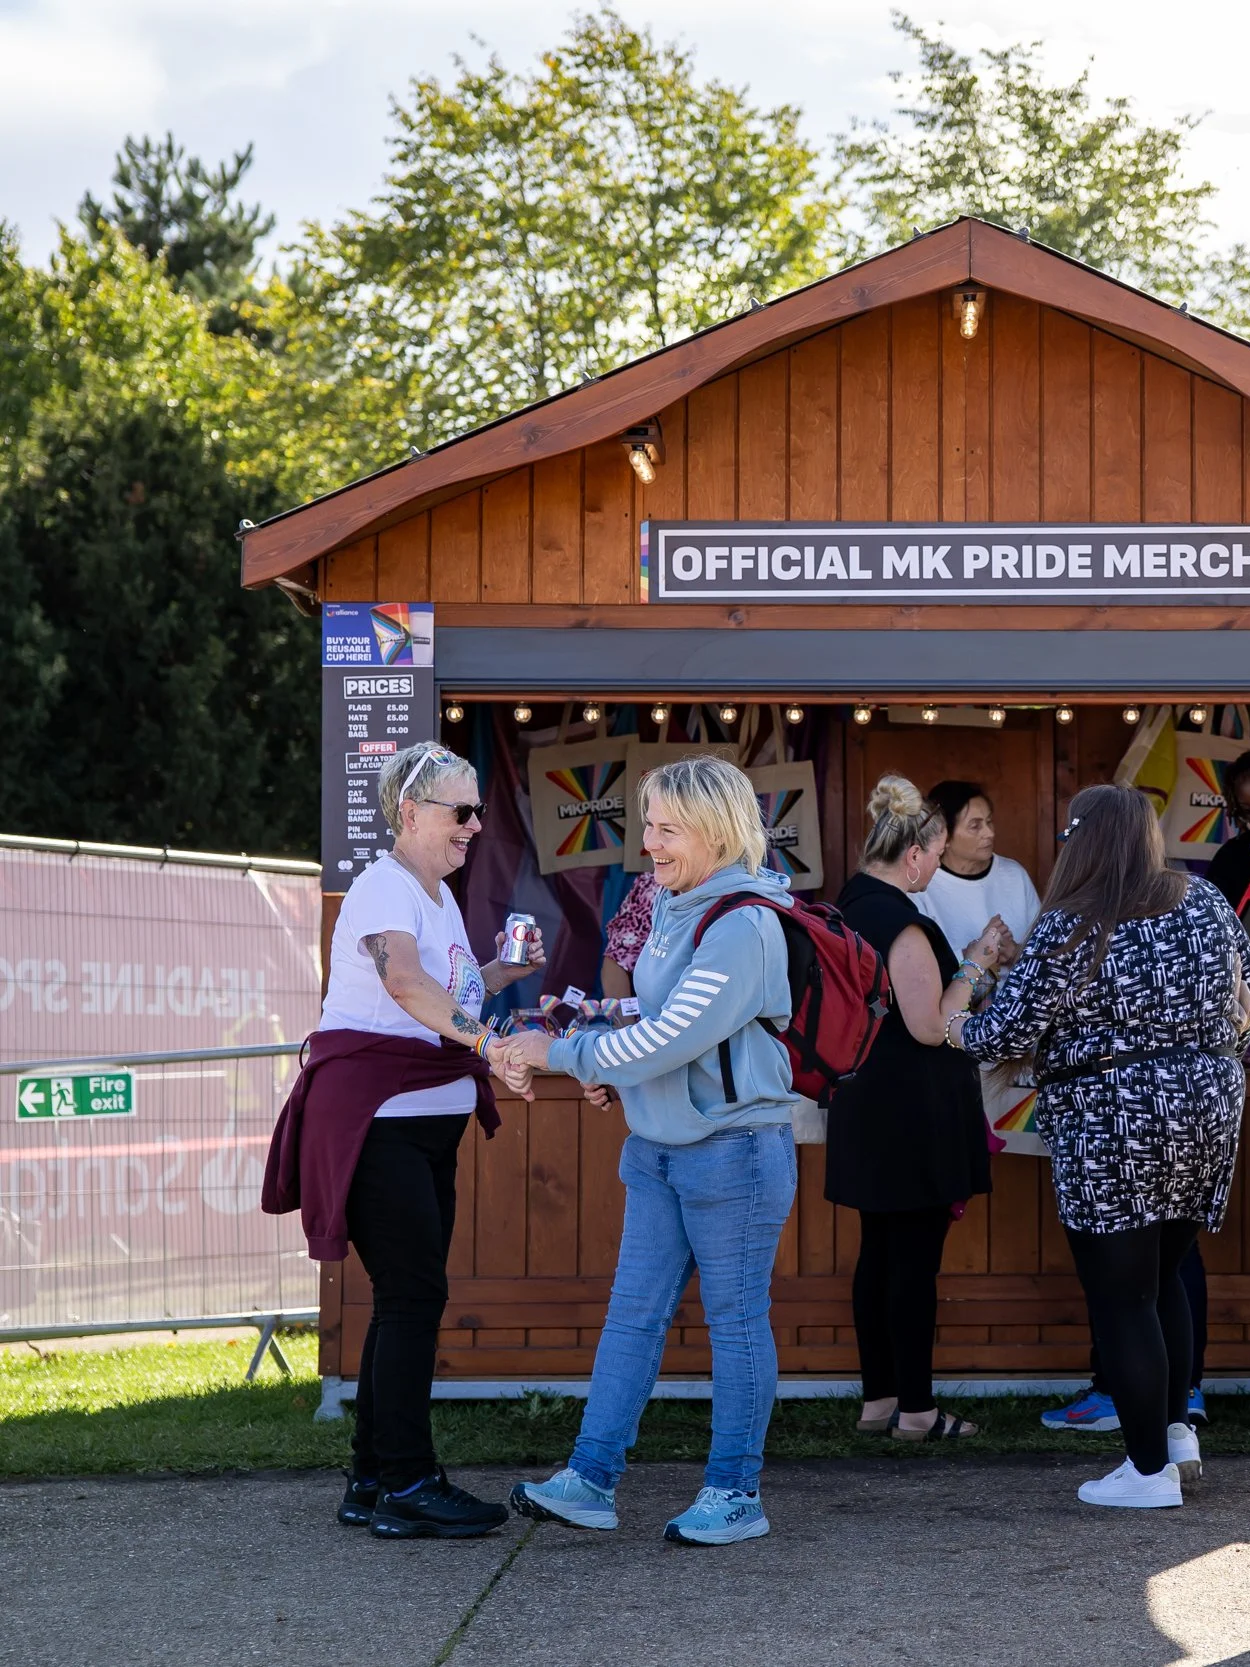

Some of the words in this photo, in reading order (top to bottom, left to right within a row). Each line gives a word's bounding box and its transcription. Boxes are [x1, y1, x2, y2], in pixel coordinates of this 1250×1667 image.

[672, 545, 873, 580] OFFICIAL
[882, 545, 953, 579] MK
[963, 544, 1093, 579] PRIDE
[326, 637, 345, 645] BUY
[346, 636, 370, 645] YOUR
[326, 645, 371, 653] REUSABLE
[326, 653, 345, 661] CUP
[346, 653, 372, 661] HERE!
[346, 678, 411, 695] PRICES
[348, 704, 372, 712] FLAGS
[386, 704, 409, 712] £5.00
[362, 744, 393, 753] OFFER
[347, 779, 369, 787] CUPS
[347, 796, 367, 804] EARS
[559, 796, 625, 818] MKPRIDE
[347, 815, 374, 823] BANDS
[347, 832, 377, 840] BADGES
[89, 1076, 127, 1094] Fire
[90, 1095, 126, 1112] exit
[723, 1505, 747, 1526] HOKA
